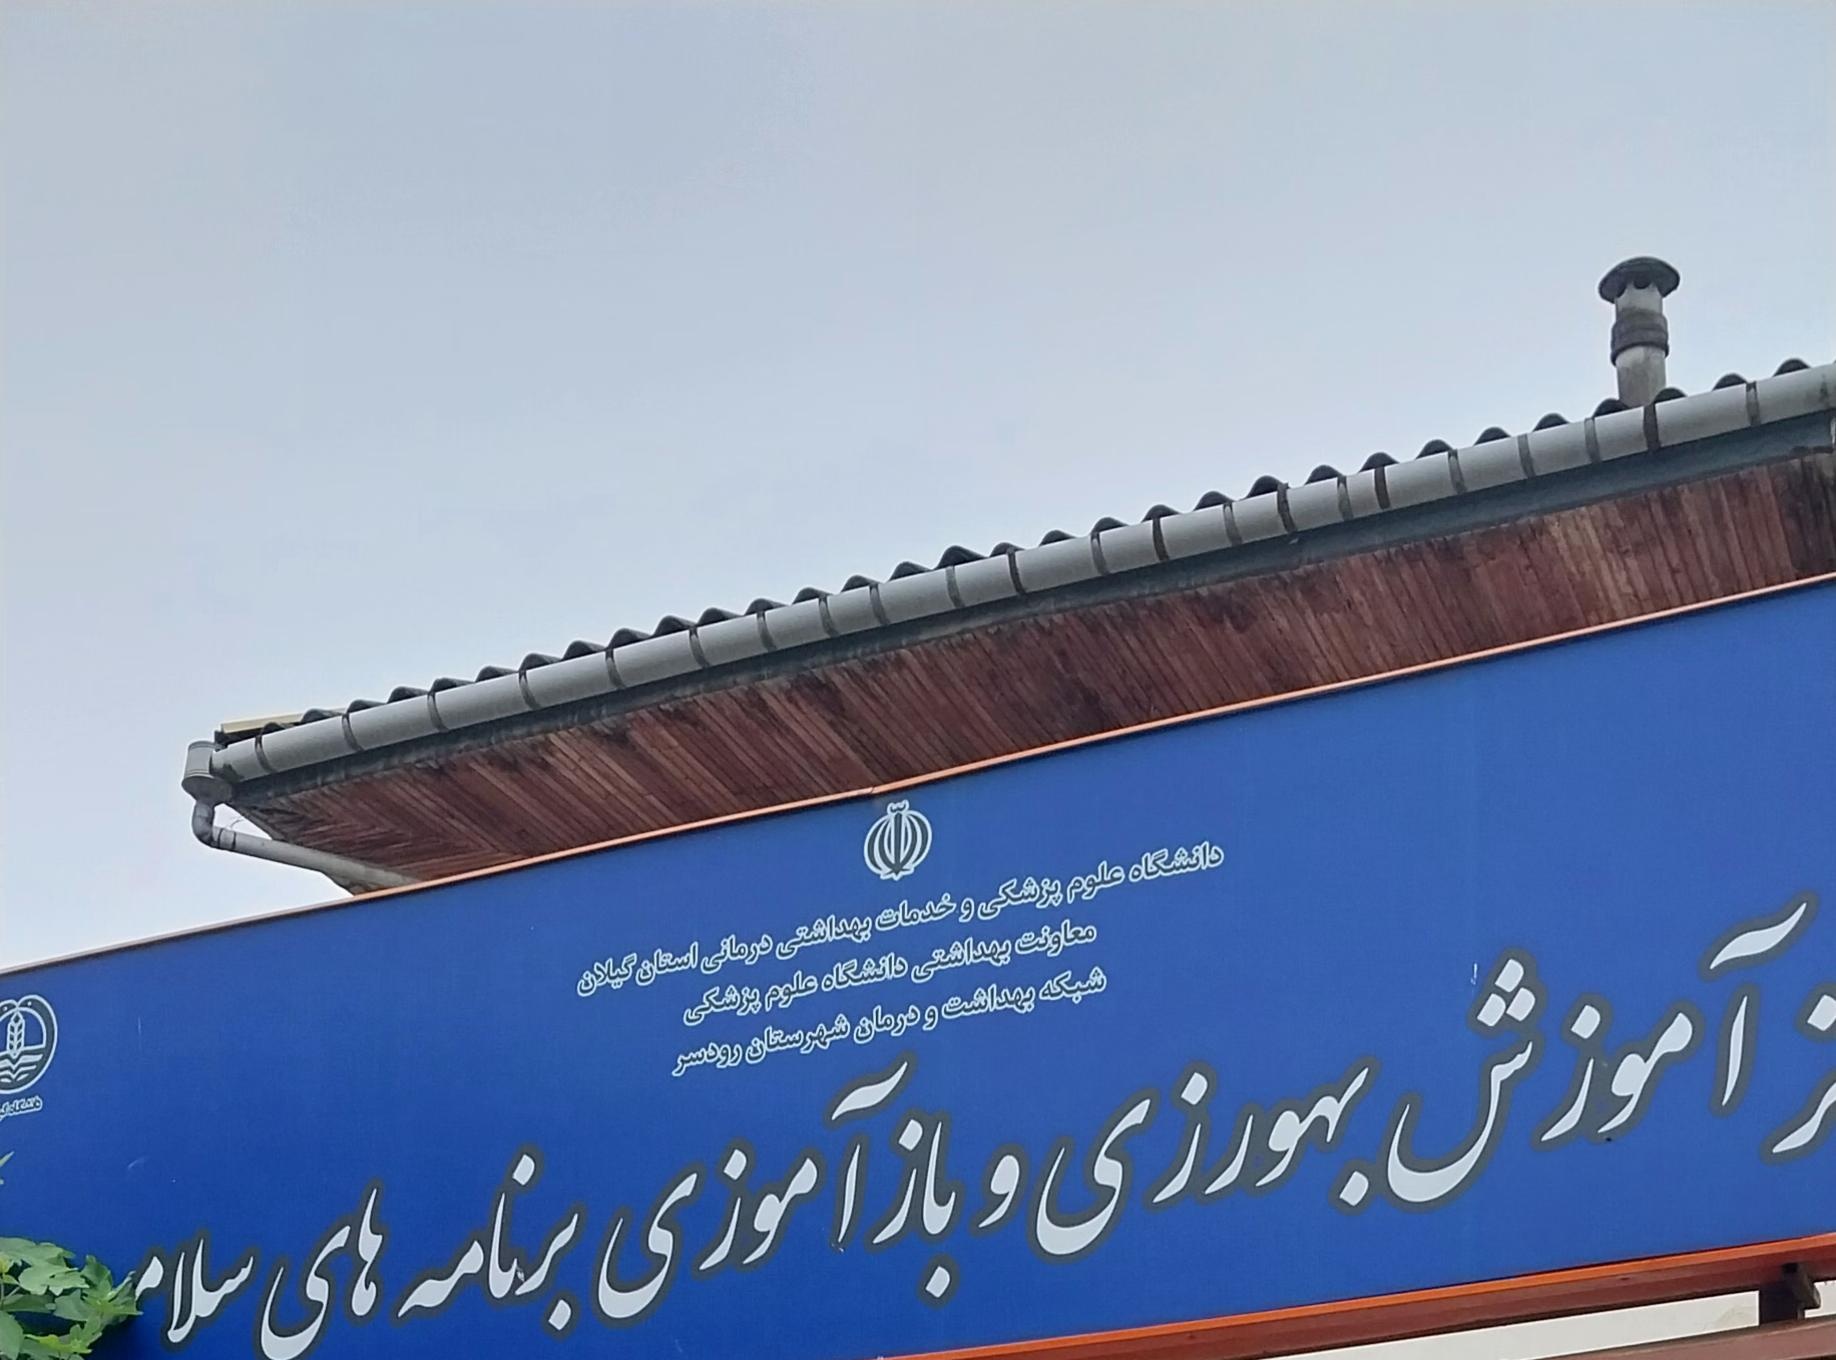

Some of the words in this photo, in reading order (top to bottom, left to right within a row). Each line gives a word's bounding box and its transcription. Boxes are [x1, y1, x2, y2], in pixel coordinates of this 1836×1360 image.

[1066, 859, 1124, 903] علوم
[1128, 841, 1225, 882] دانشگاه
[875, 892, 956, 930] خدمات
[958, 897, 974, 922] و
[977, 876, 1062, 919] پزشکی
[700, 935, 773, 974] درمانی
[776, 914, 872, 959] بهداشتی
[1014, 918, 1096, 957] معاونت
[577, 953, 637, 996] گیلان
[636, 942, 699, 984] استان
[821, 952, 908, 992] دانشگاه
[911, 936, 1012, 983] بهداشتی
[683, 984, 760, 1026] پزشکی
[765, 970, 819, 1011] علوم
[941, 985, 1036, 1020] بهداشت
[1038, 966, 1107, 1004] شبکه
[745, 1013, 851, 1064] شهرستان
[853, 1003, 920, 1043] درمان
[922, 1006, 939, 1030] و
[671, 1041, 743, 1077] رودسر
[1386, 902, 1807, 1202] آموزش
[1035, 1066, 1371, 1256] بهورزی
[978, 1153, 1021, 1229] و
[397, 1153, 580, 1334] برنامه
[135, 1237, 254, 1344] سلام
